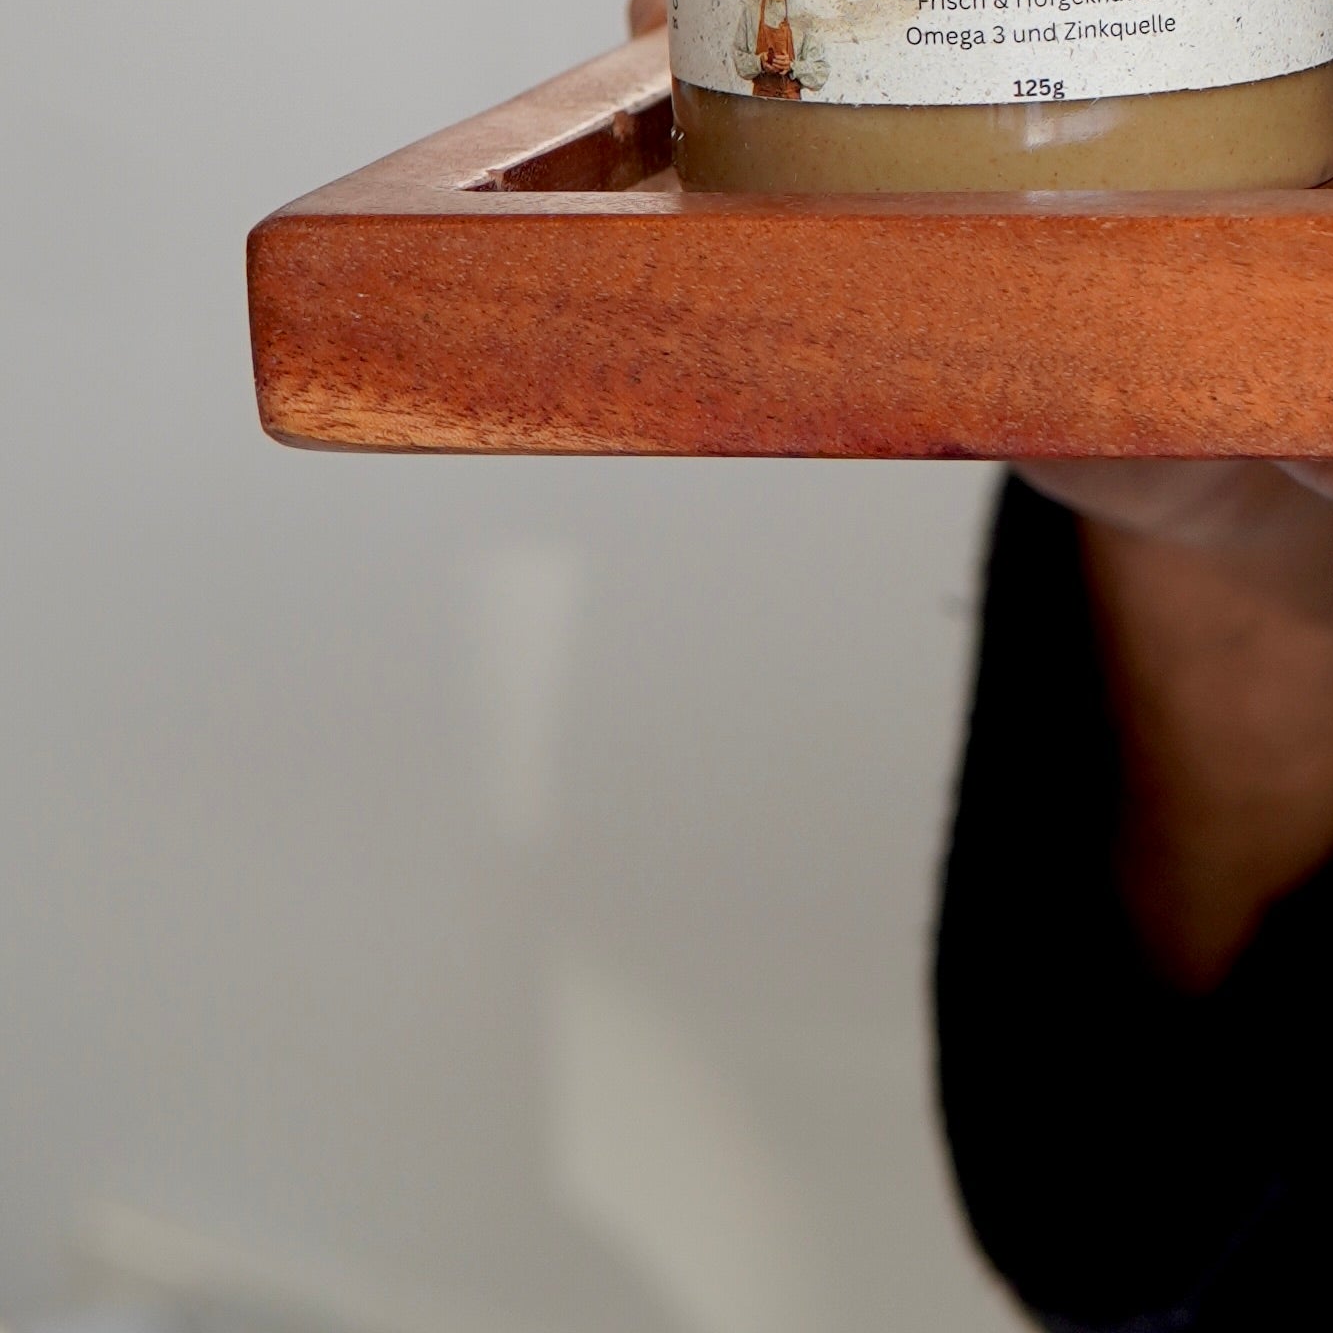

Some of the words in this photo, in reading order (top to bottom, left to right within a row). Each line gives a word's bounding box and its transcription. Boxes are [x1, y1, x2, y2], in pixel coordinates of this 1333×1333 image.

[906, 26, 986, 50] Omega
[993, 25, 1005, 44] 3
[1013, 23, 1058, 43] und
[1064, 14, 1176, 41] Zinkquelle
[1013, 78, 1065, 99] 125g
